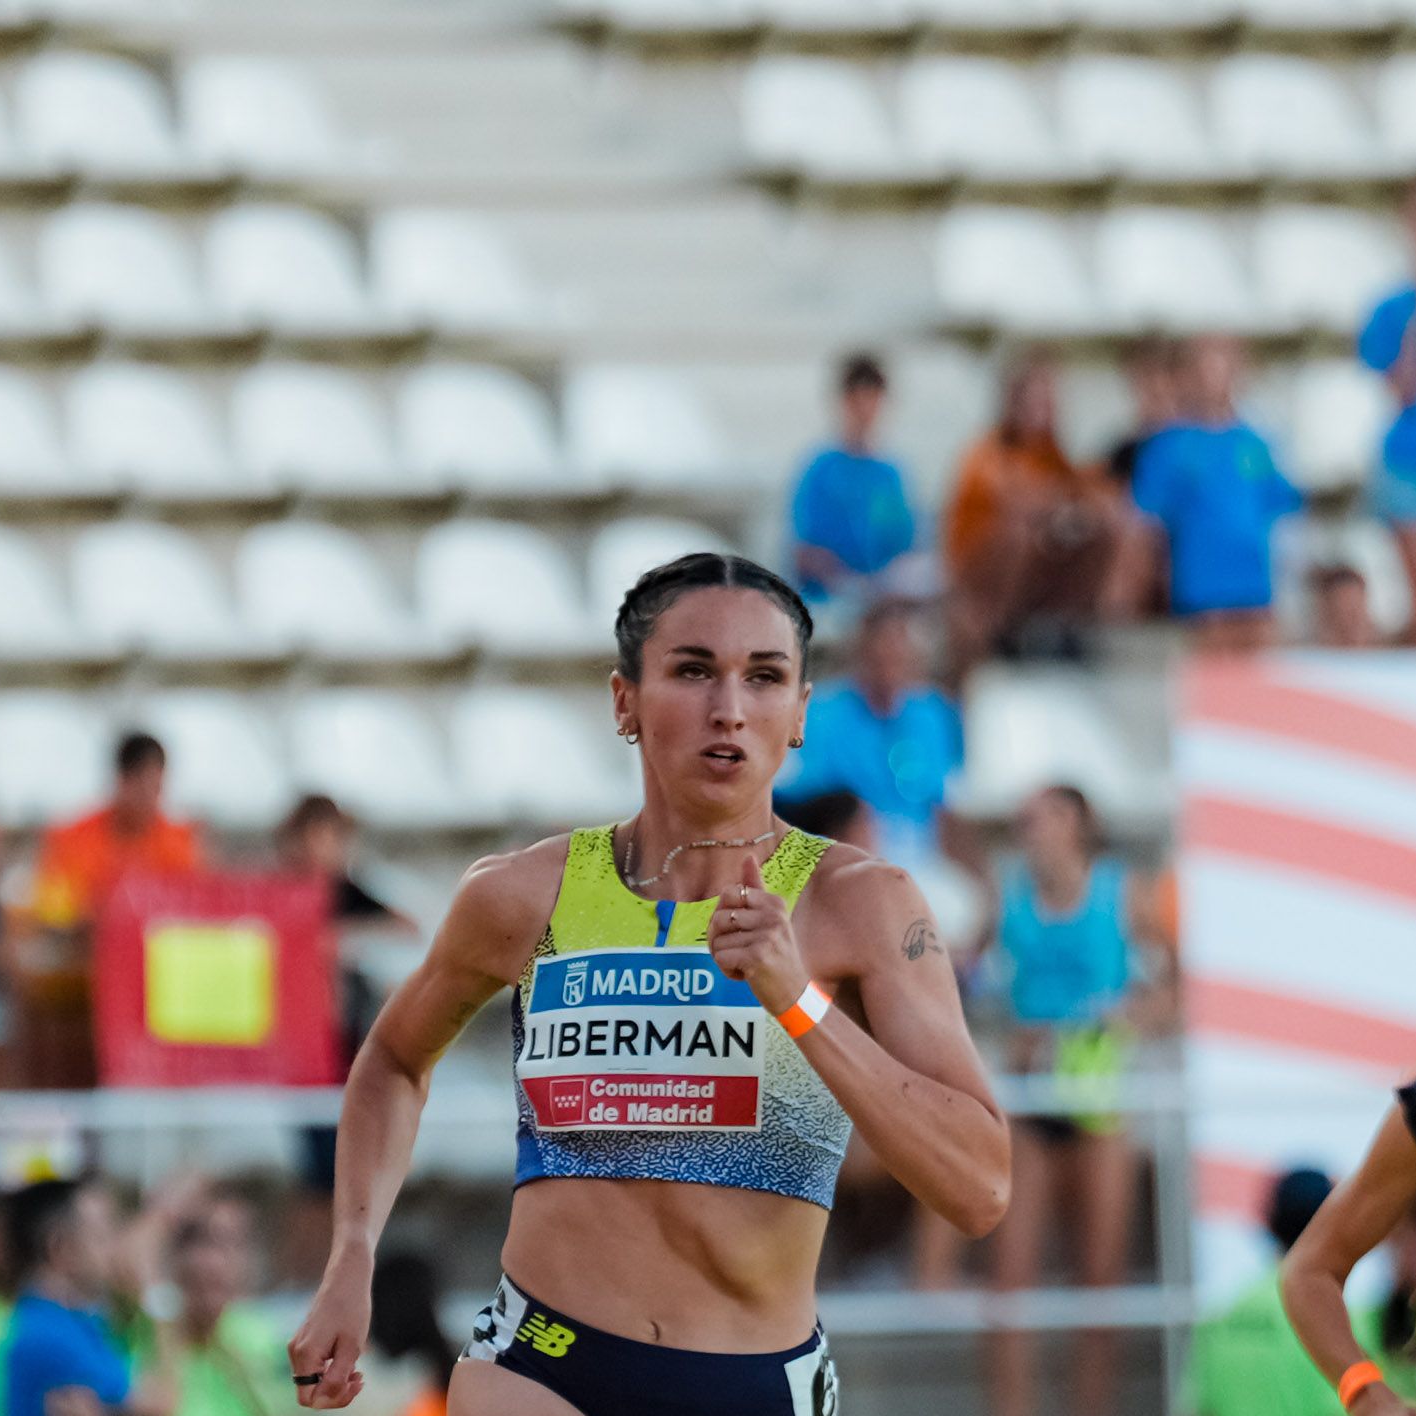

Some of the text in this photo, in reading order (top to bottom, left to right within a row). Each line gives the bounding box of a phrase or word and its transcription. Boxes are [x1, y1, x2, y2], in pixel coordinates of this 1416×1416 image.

[591, 968, 715, 1002] MADRID
[525, 1019, 755, 1061] LIBERMAN
[589, 1078, 716, 1099] Comunidad
[588, 1102, 713, 1124] de Madrid
